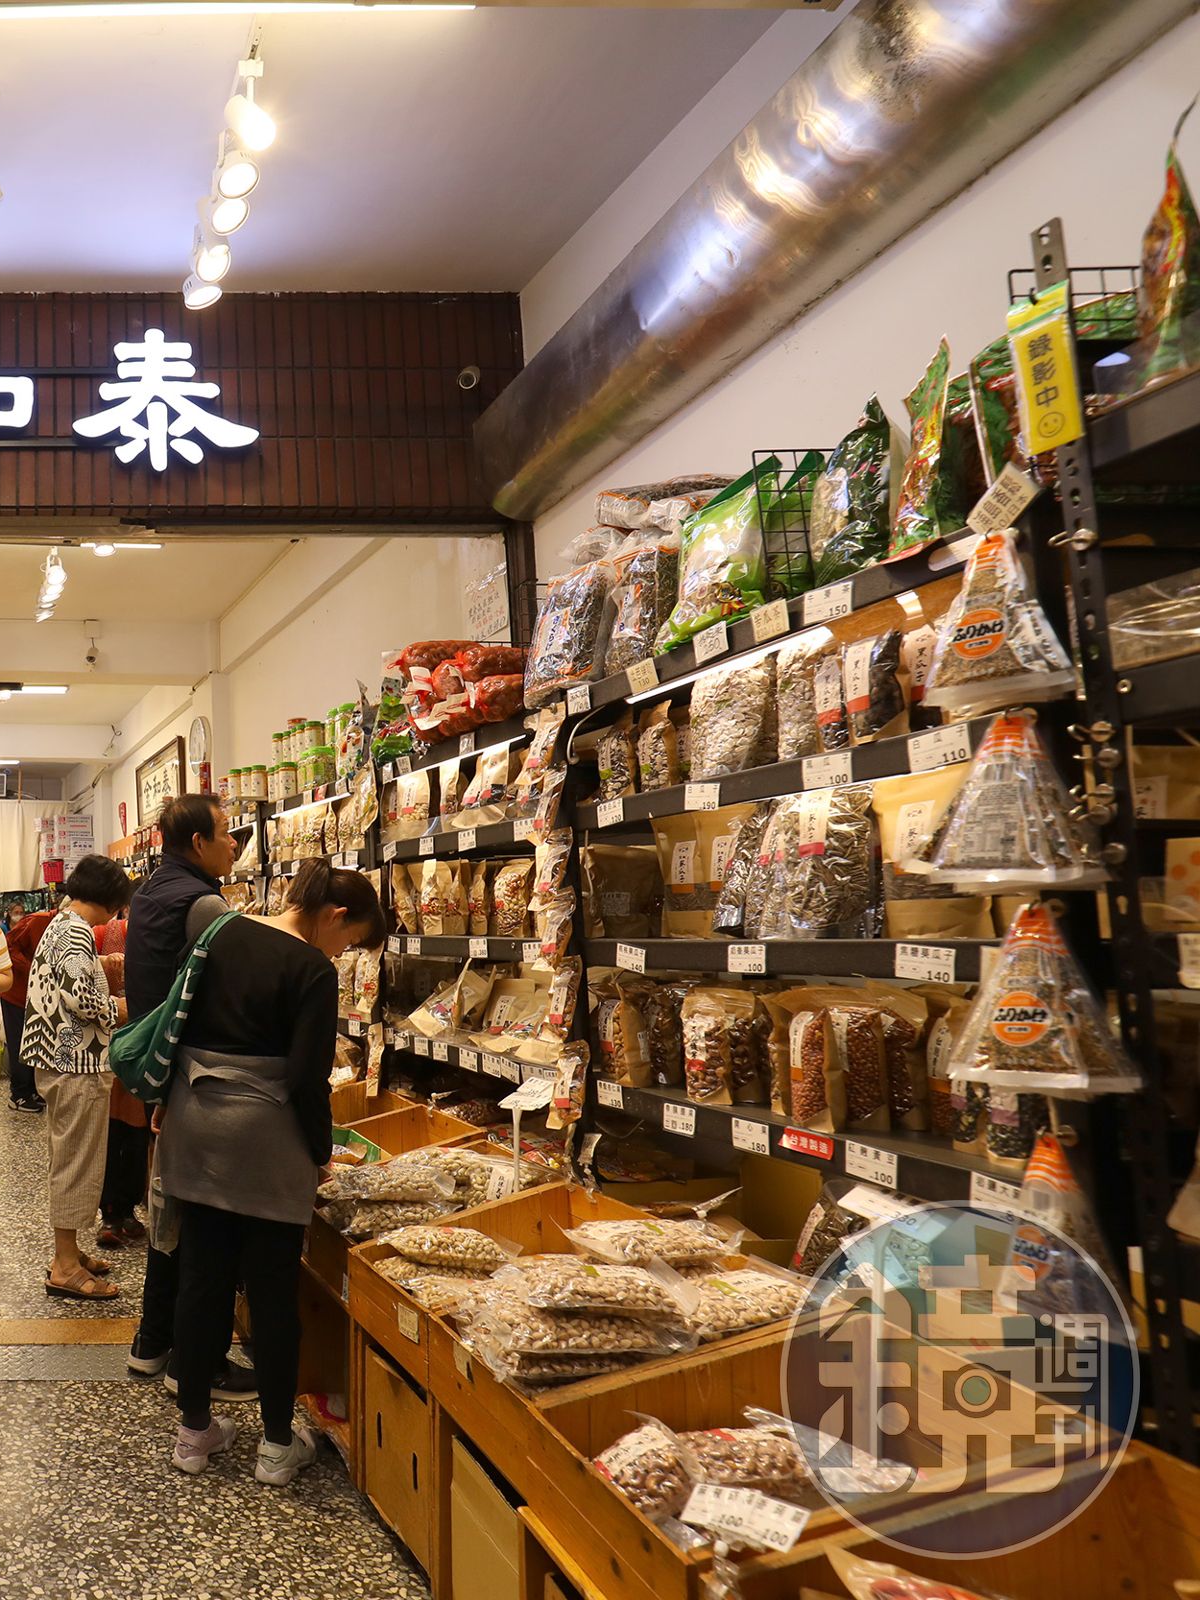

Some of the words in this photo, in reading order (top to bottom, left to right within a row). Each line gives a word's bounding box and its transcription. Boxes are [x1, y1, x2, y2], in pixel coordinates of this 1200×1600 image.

[828, 604, 848, 617] 150
[952, 620, 1005, 643] ふりかけ
[942, 748, 966, 763] 110
[830, 773, 848, 785] 100
[702, 801, 716, 810] 190
[631, 963, 643, 973] 140
[747, 963, 763, 972] 100
[927, 970, 950, 983] 140
[681, 1121, 693, 1132] 180
[751, 1141, 767, 1154] 180
[788, 1133, 829, 1155] 台灣製造
[874, 1171, 893, 1185] 100
[719, 1513, 743, 1527] 100
[761, 1528, 789, 1547] 100
